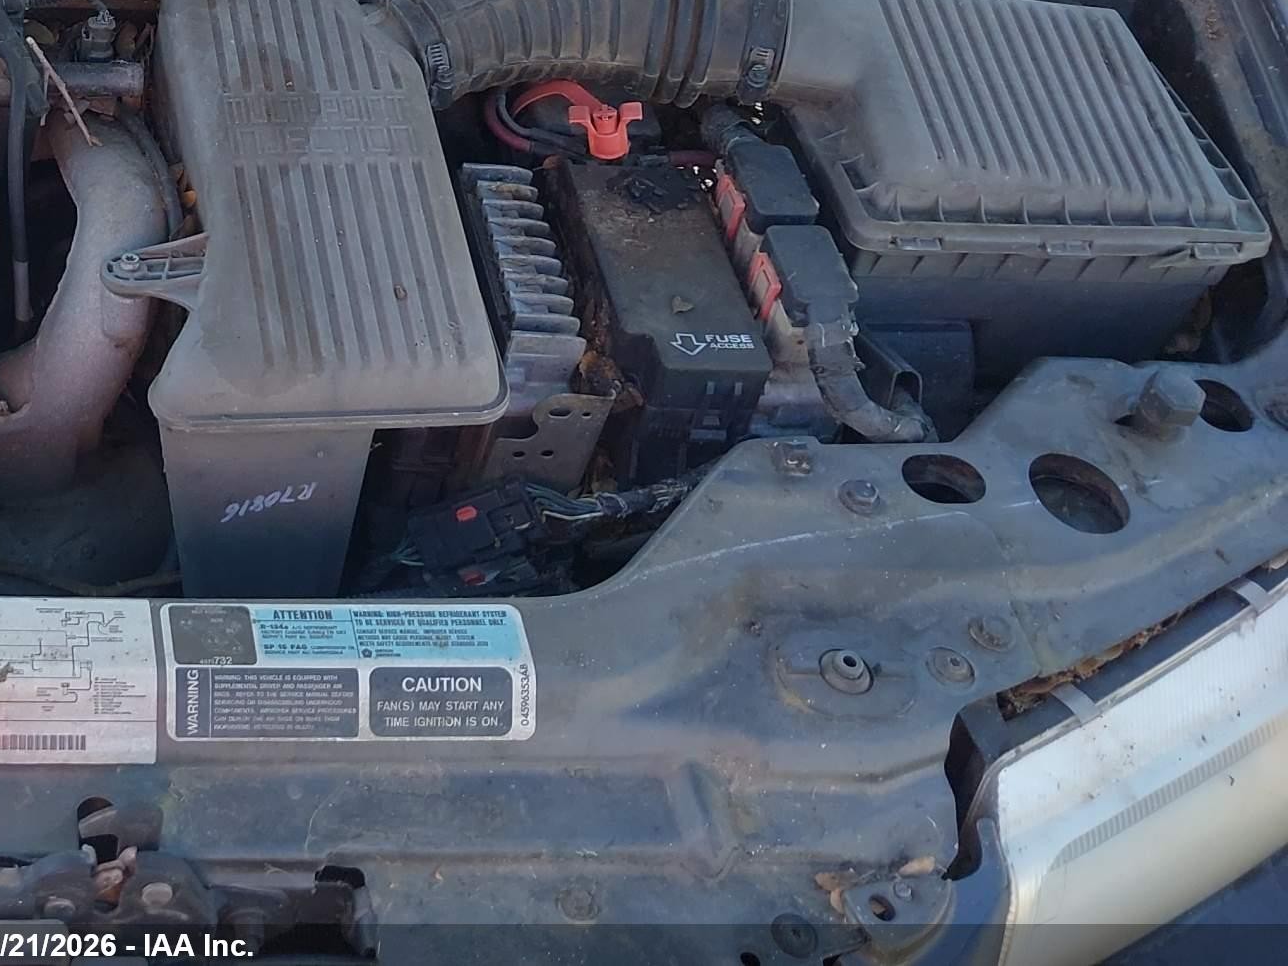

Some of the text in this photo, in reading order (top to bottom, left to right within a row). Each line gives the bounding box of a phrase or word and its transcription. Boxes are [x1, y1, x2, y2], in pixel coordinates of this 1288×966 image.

[705, 334, 753, 343] FUSE
[220, 481, 319, 523] R70816
[273, 609, 333, 620] ATTENTION
[402, 676, 482, 693] CAUTION
[187, 669, 200, 735] WARNING
[377, 701, 505, 712] FAN(S) MAY START ANY
[384, 716, 409, 727] TIME
[414, 716, 461, 727] IGNITION
[465, 716, 477, 727] IS
